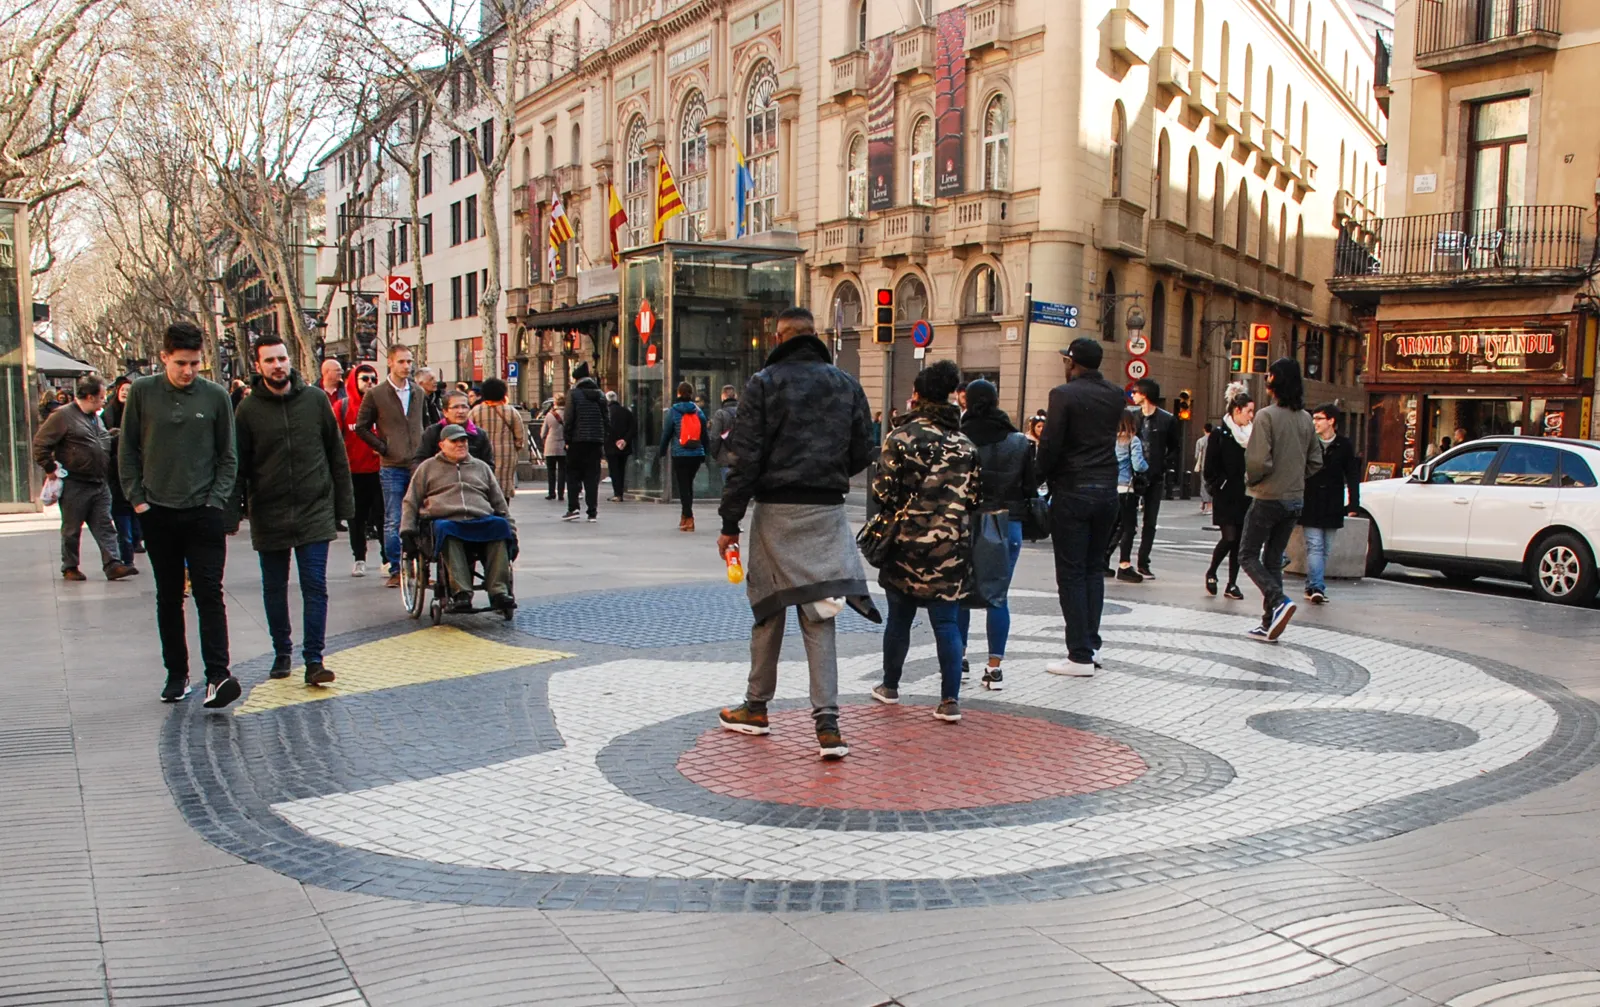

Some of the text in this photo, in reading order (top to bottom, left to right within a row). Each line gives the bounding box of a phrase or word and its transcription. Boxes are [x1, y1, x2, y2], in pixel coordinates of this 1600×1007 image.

[1564, 154, 1575, 163] 67
[395, 282, 404, 290] M
[641, 311, 650, 333] M
[1396, 334, 1554, 362] AROMAS DE ISTANBUL
[1497, 358, 1520, 366] GRILL
[509, 364, 516, 376] P
[1132, 365, 1142, 373] 10
